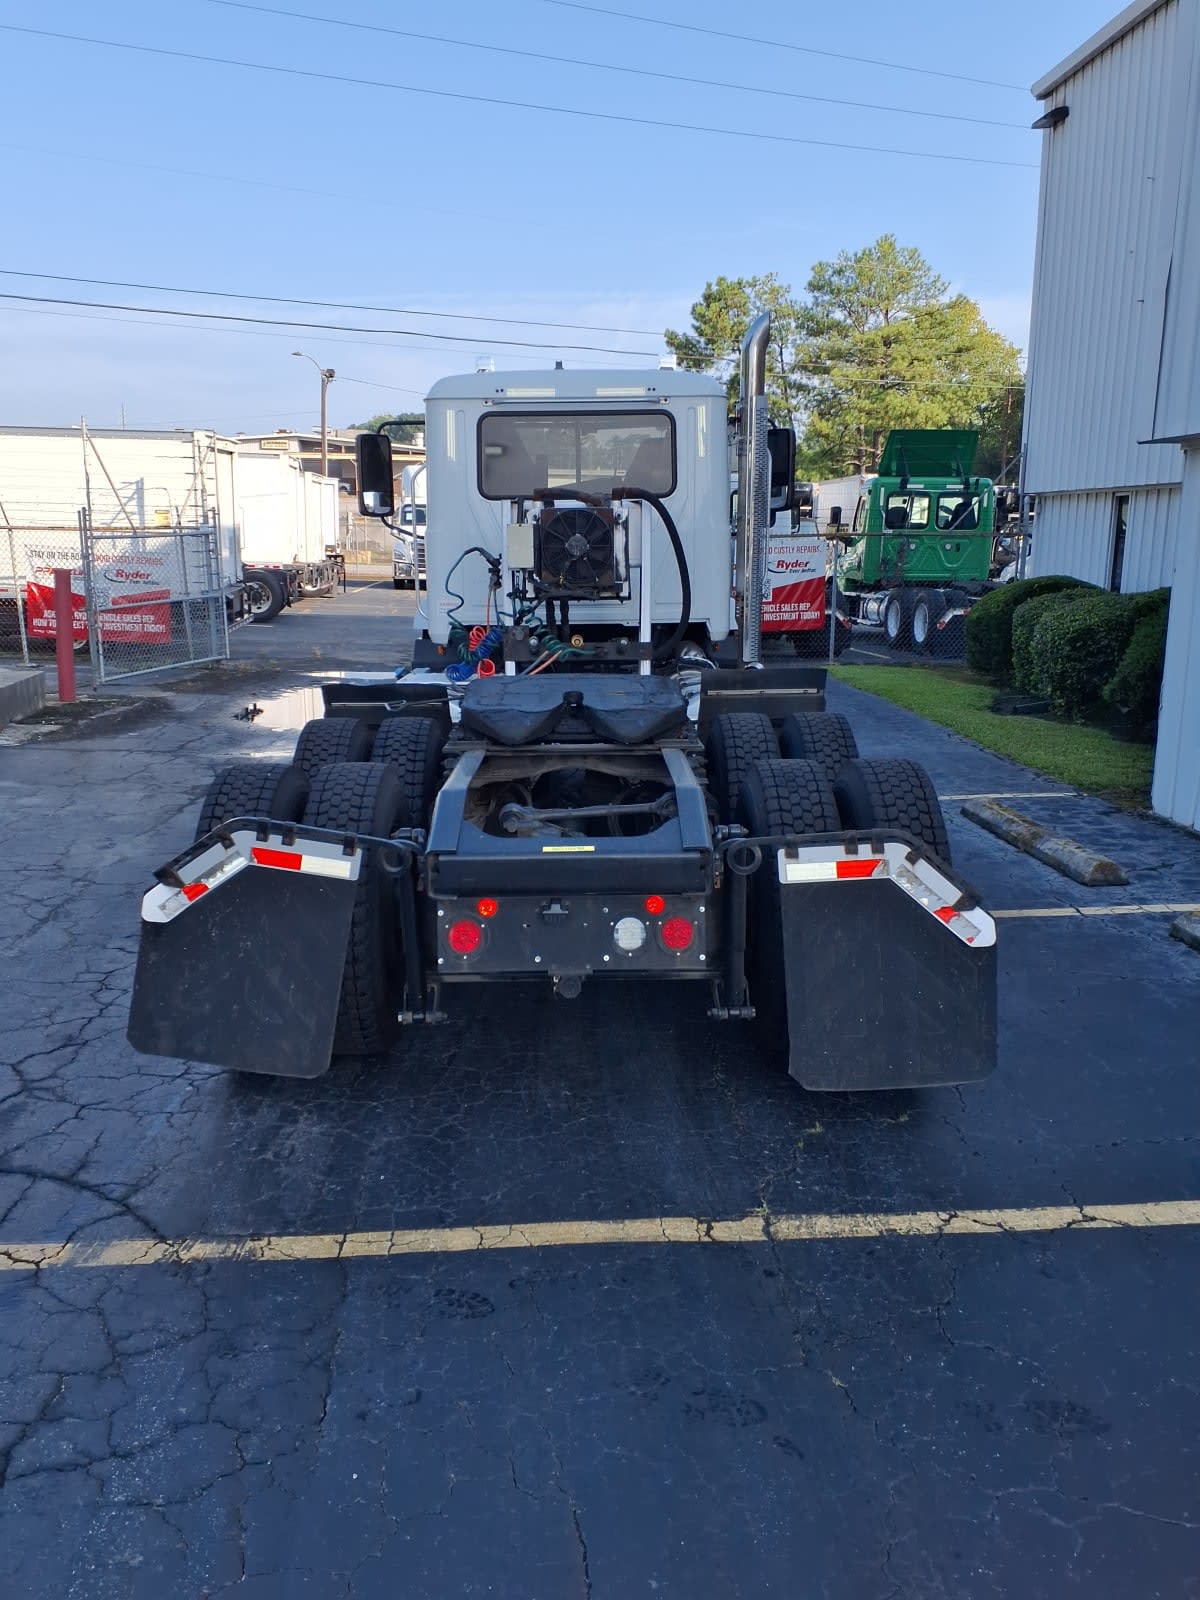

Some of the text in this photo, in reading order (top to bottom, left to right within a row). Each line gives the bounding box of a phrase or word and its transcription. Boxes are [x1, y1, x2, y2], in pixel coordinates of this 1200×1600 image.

[30, 550, 45, 559] STAY
[47, 551, 55, 560] ON
[57, 552, 70, 560] THE
[774, 546, 794, 554] COSTLY
[776, 560, 810, 570] Ryder
[115, 569, 152, 581] Ryder
[761, 602, 810, 612] EHICLE SALES REP
[99, 613, 122, 622] EHICLE
[764, 611, 820, 621] INVESTMENT TODAY!
[33, 618, 47, 627] HOW
[104, 623, 142, 632] INVESTMENT
